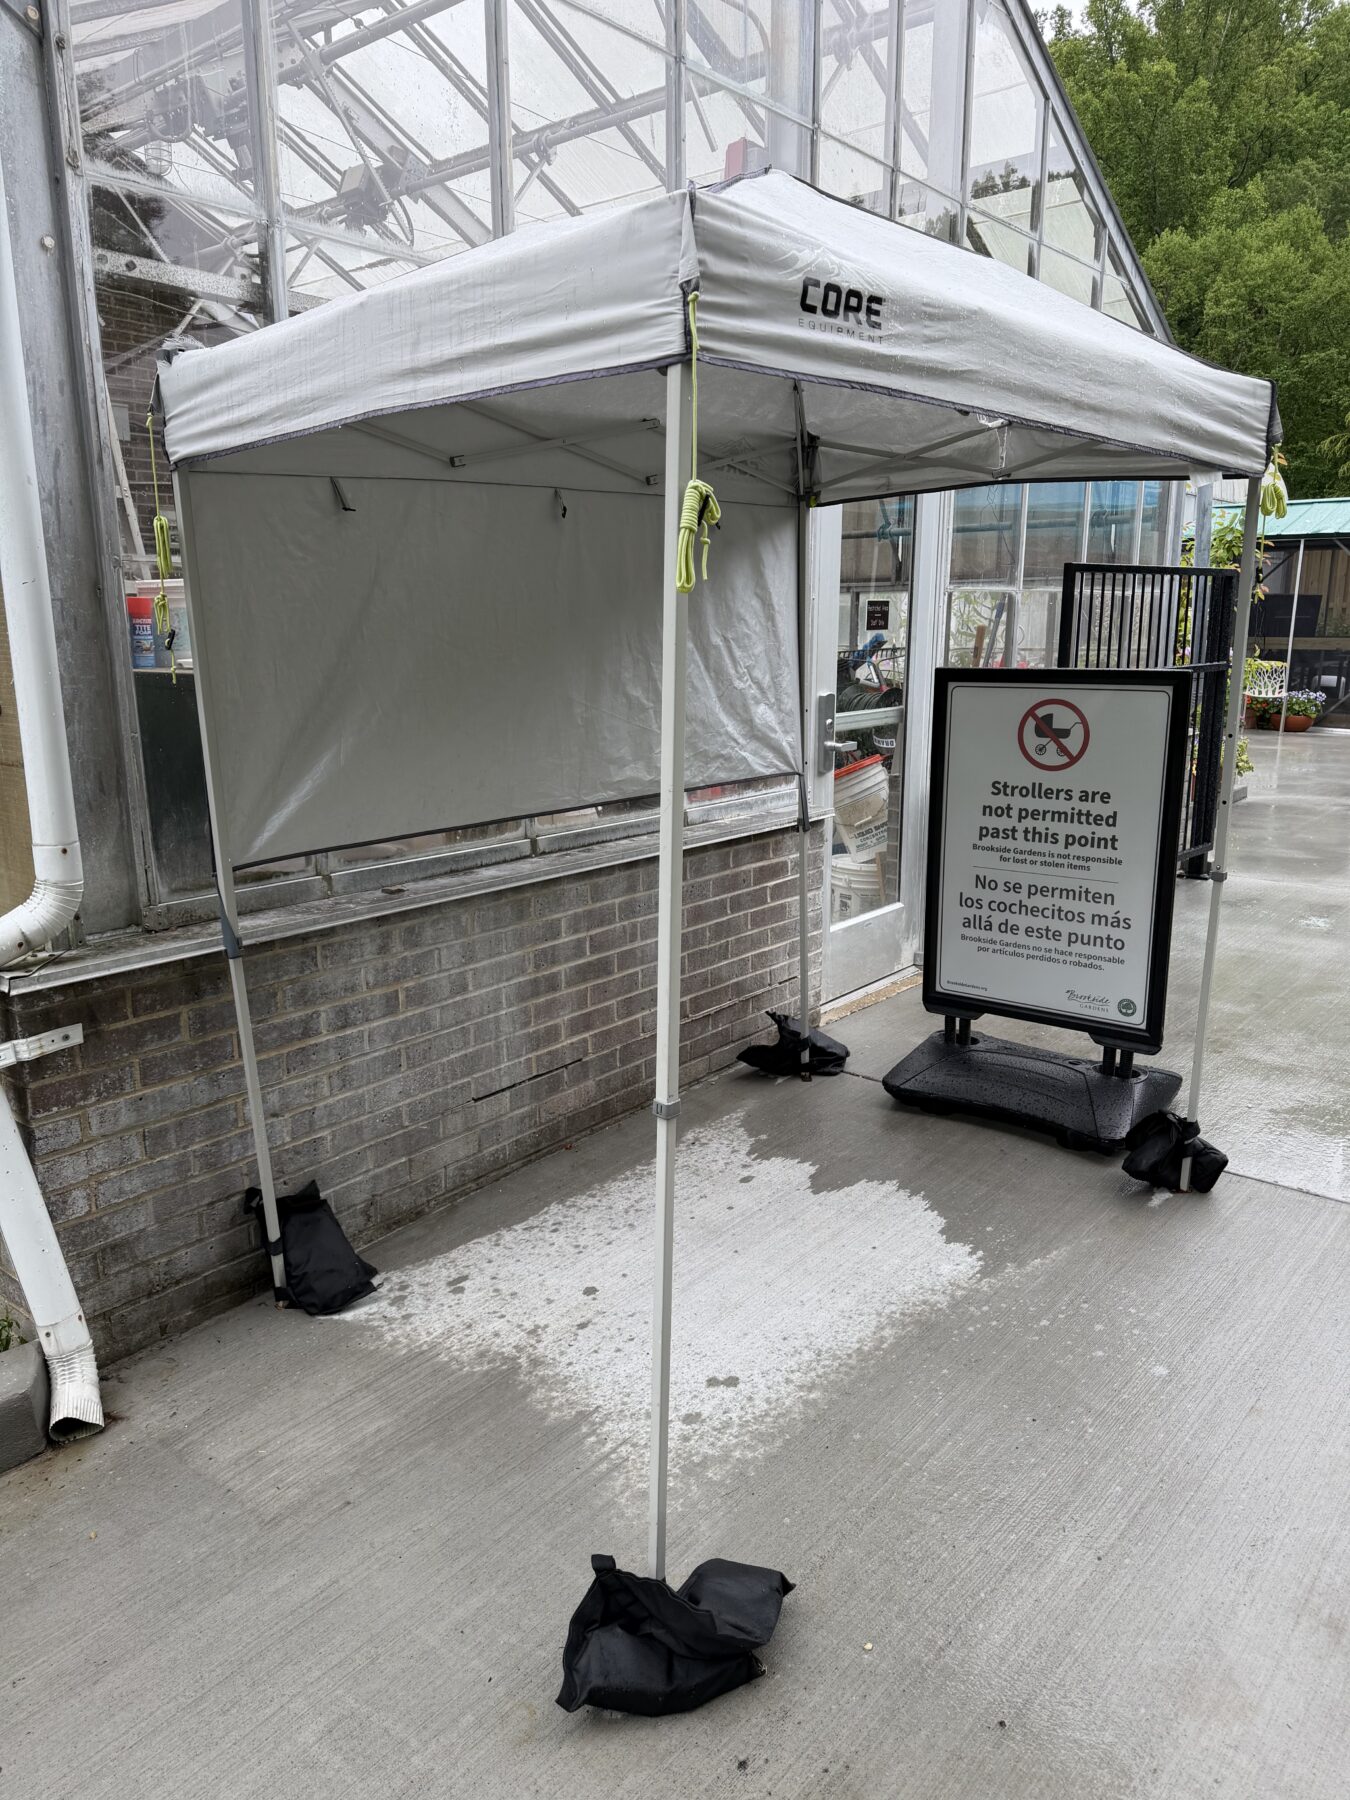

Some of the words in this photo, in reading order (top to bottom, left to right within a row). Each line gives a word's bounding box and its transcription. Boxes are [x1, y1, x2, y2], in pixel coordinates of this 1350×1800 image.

[800, 276, 885, 330] CORE
[798, 318, 885, 344] EQUIPMENT
[991, 780, 1073, 801] Strollers
[1078, 789, 1111, 804] are
[982, 803, 1013, 818] not
[1018, 807, 1118, 827] permitted
[978, 825, 1018, 841] past
[1023, 826, 1059, 844] this
[1064, 831, 1118, 850] point
[972, 843, 1011, 854] Brookside
[1012, 847, 1046, 858] Gardens
[1048, 850, 1055, 858] is
[1057, 852, 1070, 860] not
[1072, 854, 1123, 866] responsible
[999, 854, 1011, 863] for
[1012, 856, 1028, 865] lost
[1039, 859, 1065, 869] stolen
[1066, 863, 1091, 871] items
[975, 874, 998, 891] No
[1003, 880, 1022, 894] se
[1027, 883, 1115, 906] permiten
[959, 892, 983, 910] los
[988, 900, 1085, 923] cochecitos
[1091, 910, 1132, 930] más
[962, 914, 993, 932] allá
[998, 918, 1020, 935] de
[1024, 925, 1062, 942] este
[1067, 931, 1125, 951] punto
[960, 934, 998, 946] Brookside
[999, 940, 1031, 951] Gardens
[1032, 945, 1042, 953] no
[1043, 946, 1053, 954] se
[1054, 947, 1073, 958] hace
[1074, 952, 1125, 965] responsable
[977, 945, 990, 954] por
[991, 946, 1025, 959] artículos
[1026, 952, 1061, 965] perdidos
[1069, 959, 1105, 971] robados.
[1065, 989, 1111, 1005] Brookside
[1079, 1003, 1109, 1013] GARDENS
